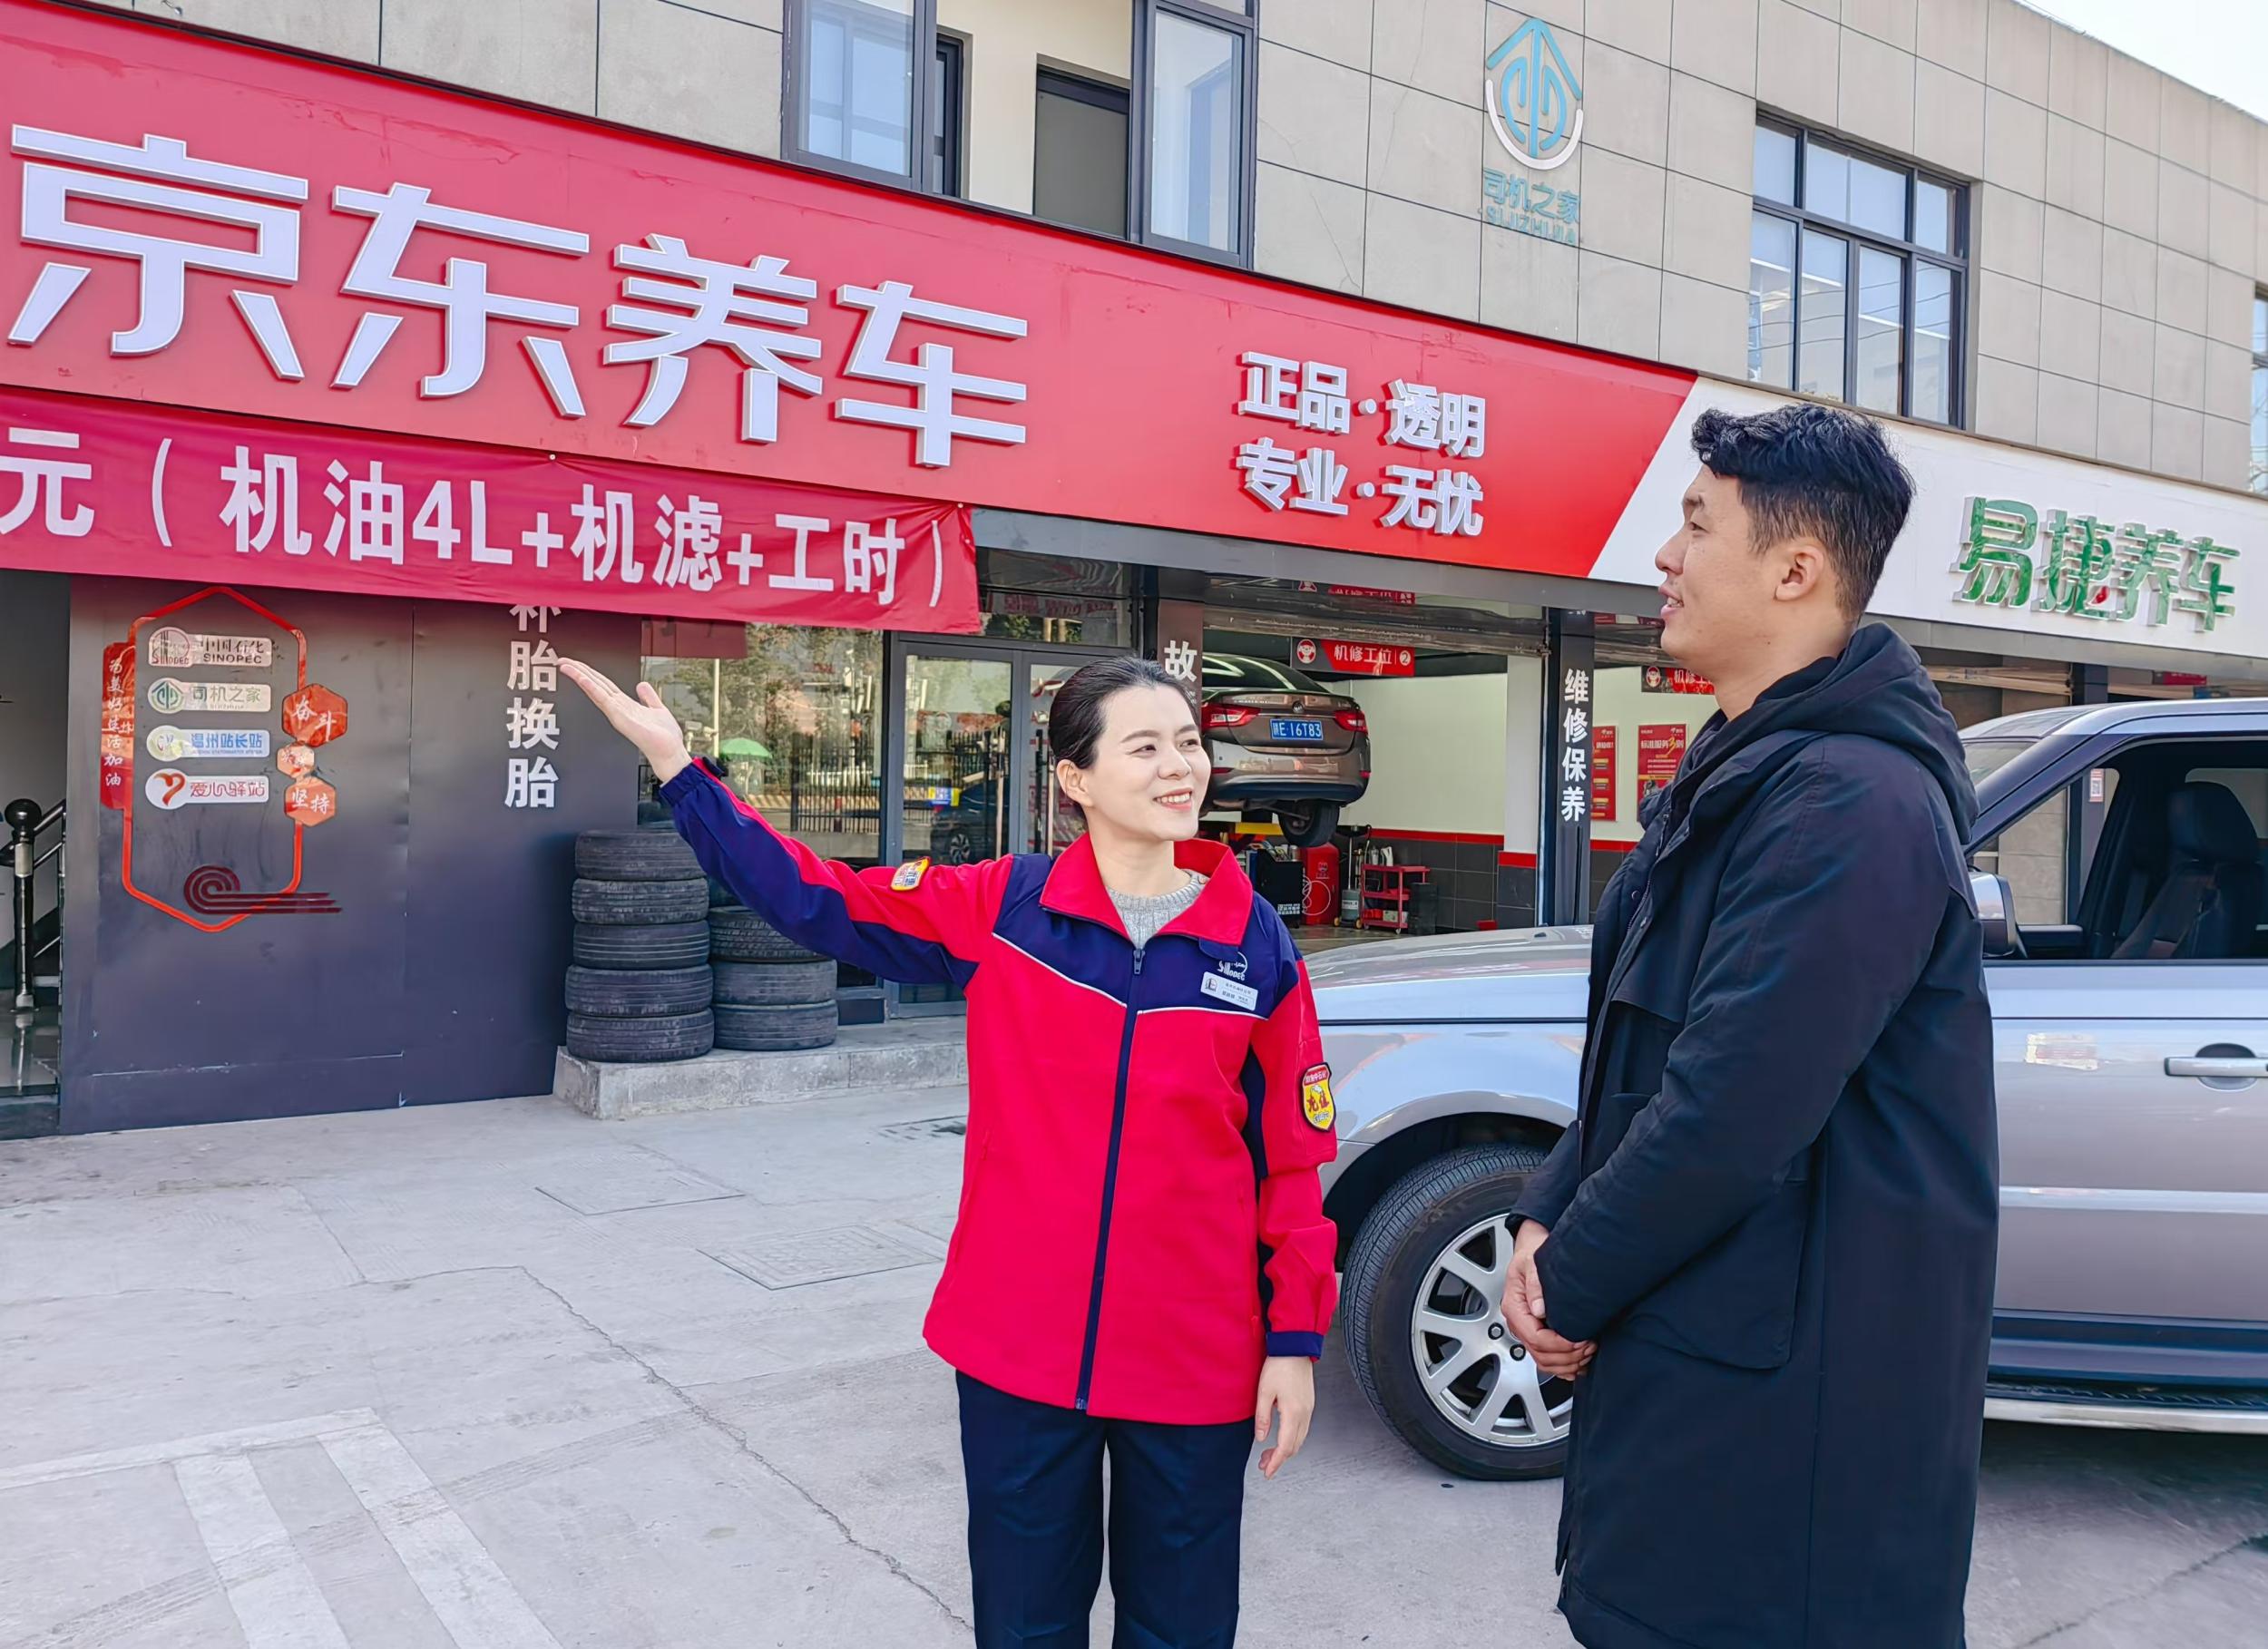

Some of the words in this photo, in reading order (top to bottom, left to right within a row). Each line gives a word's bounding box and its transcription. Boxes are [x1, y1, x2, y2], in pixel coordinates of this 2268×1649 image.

[1483, 168, 1579, 225] 司机之家
[8, 123, 1028, 467] 京东养车
[1237, 351, 1486, 457] 正品·透明
[1235, 436, 1484, 536] 专业·无忧
[1950, 496, 2241, 632] 易捷养车
[203, 653, 262, 664] SINOPEC
[1164, 639, 1198, 705] 故
[1334, 644, 1393, 664] 机修工位
[192, 686, 261, 703] 司机之家
[291, 695, 337, 743] 奋斗
[191, 733, 262, 748] 温州站长站
[1561, 668, 1589, 822] 维修保养
[190, 781, 265, 797] 爱心驿站
[291, 787, 330, 815] 坚持
